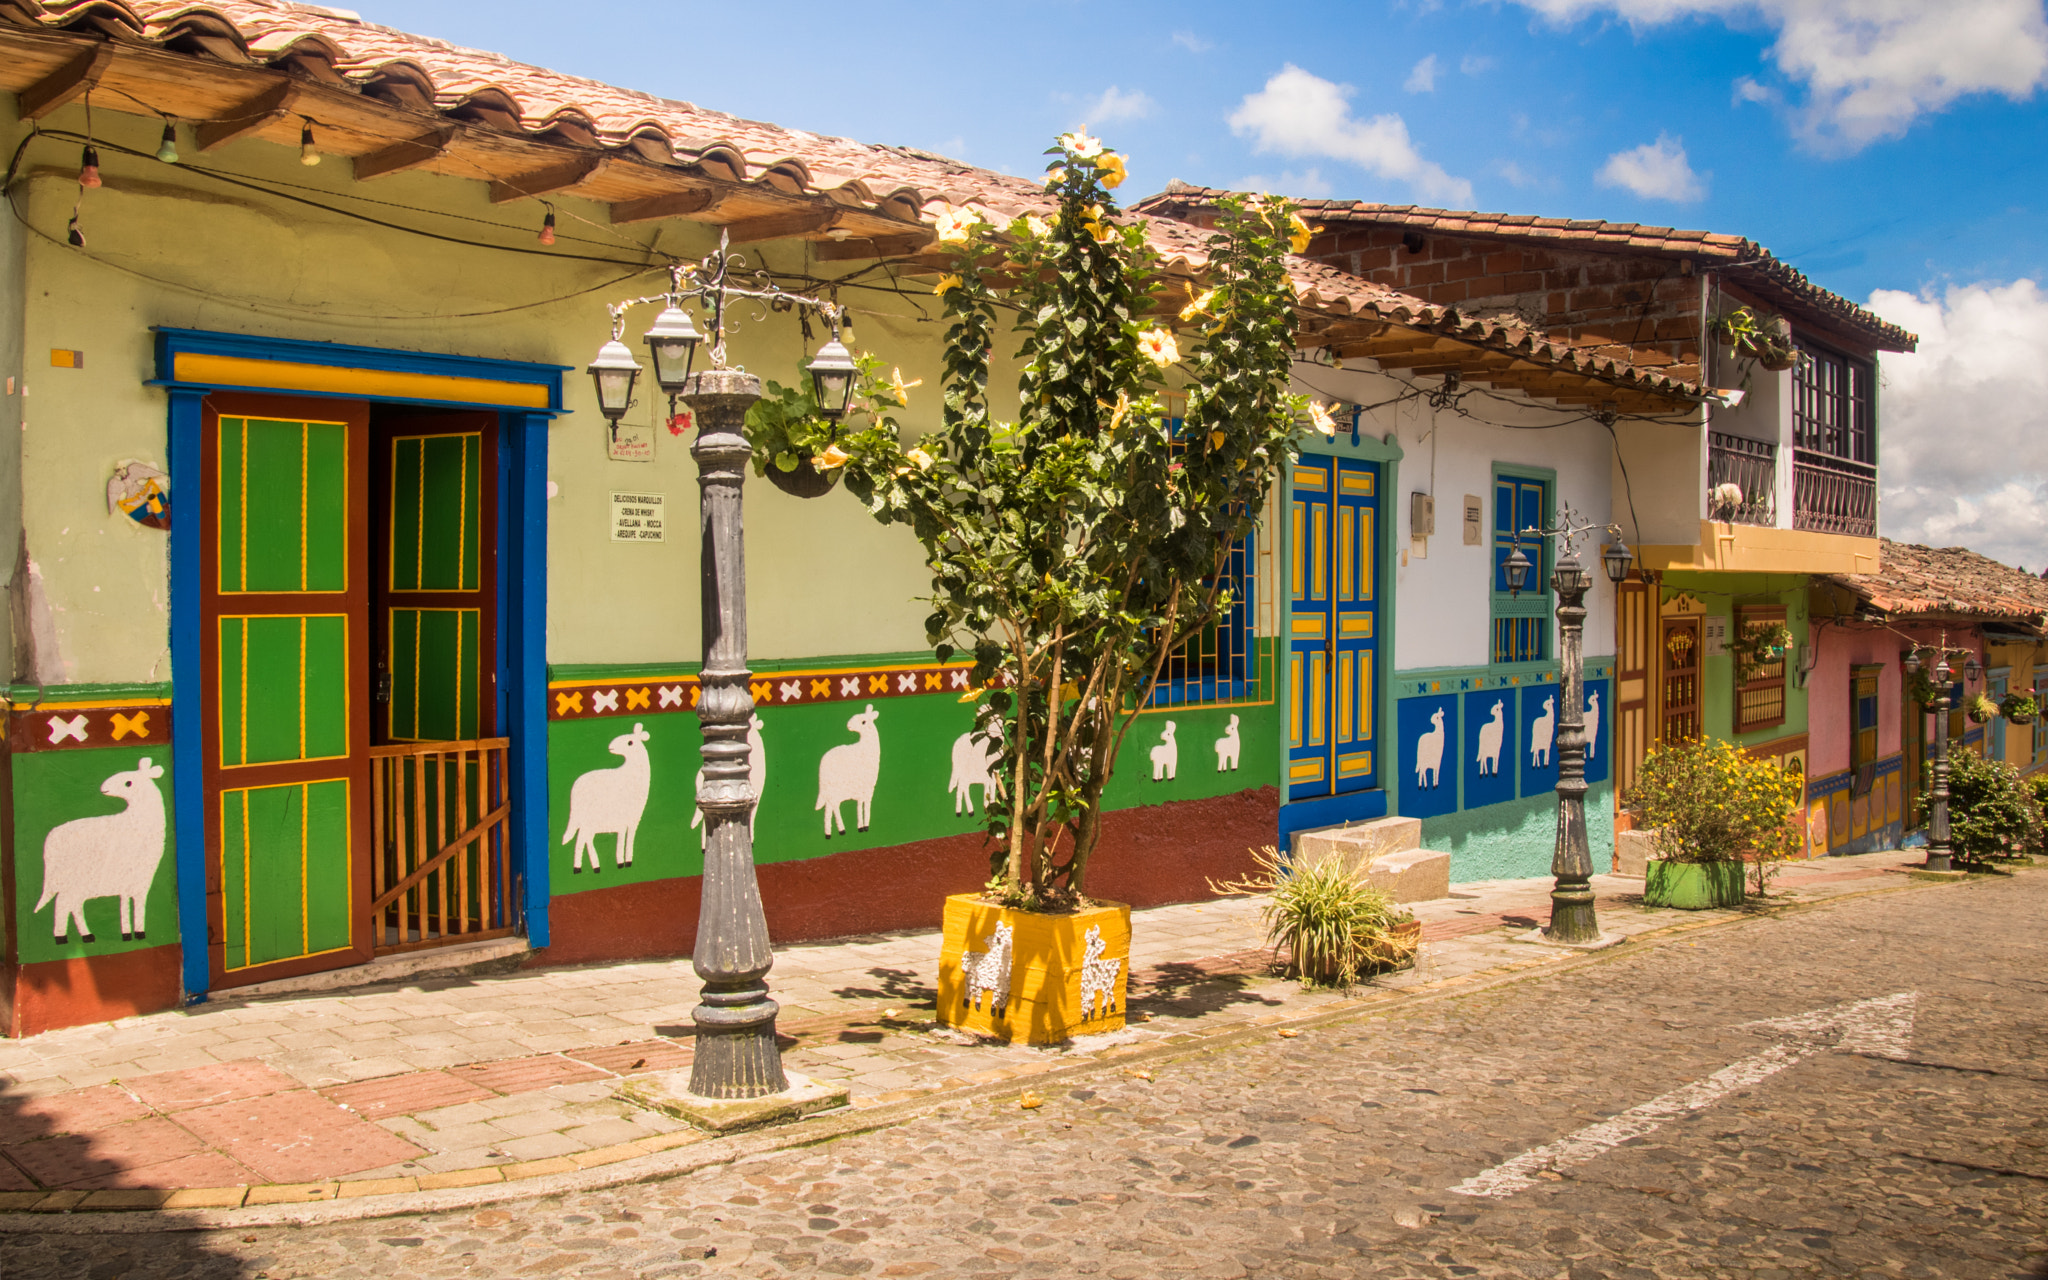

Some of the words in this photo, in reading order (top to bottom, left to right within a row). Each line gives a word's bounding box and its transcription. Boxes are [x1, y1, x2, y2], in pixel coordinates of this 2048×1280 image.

[614, 494, 637, 503] DELICIOSOS
[619, 519, 641, 527] AVELLANA
[646, 520, 662, 528] MOCCA
[617, 530, 636, 538] AREQUIPE
